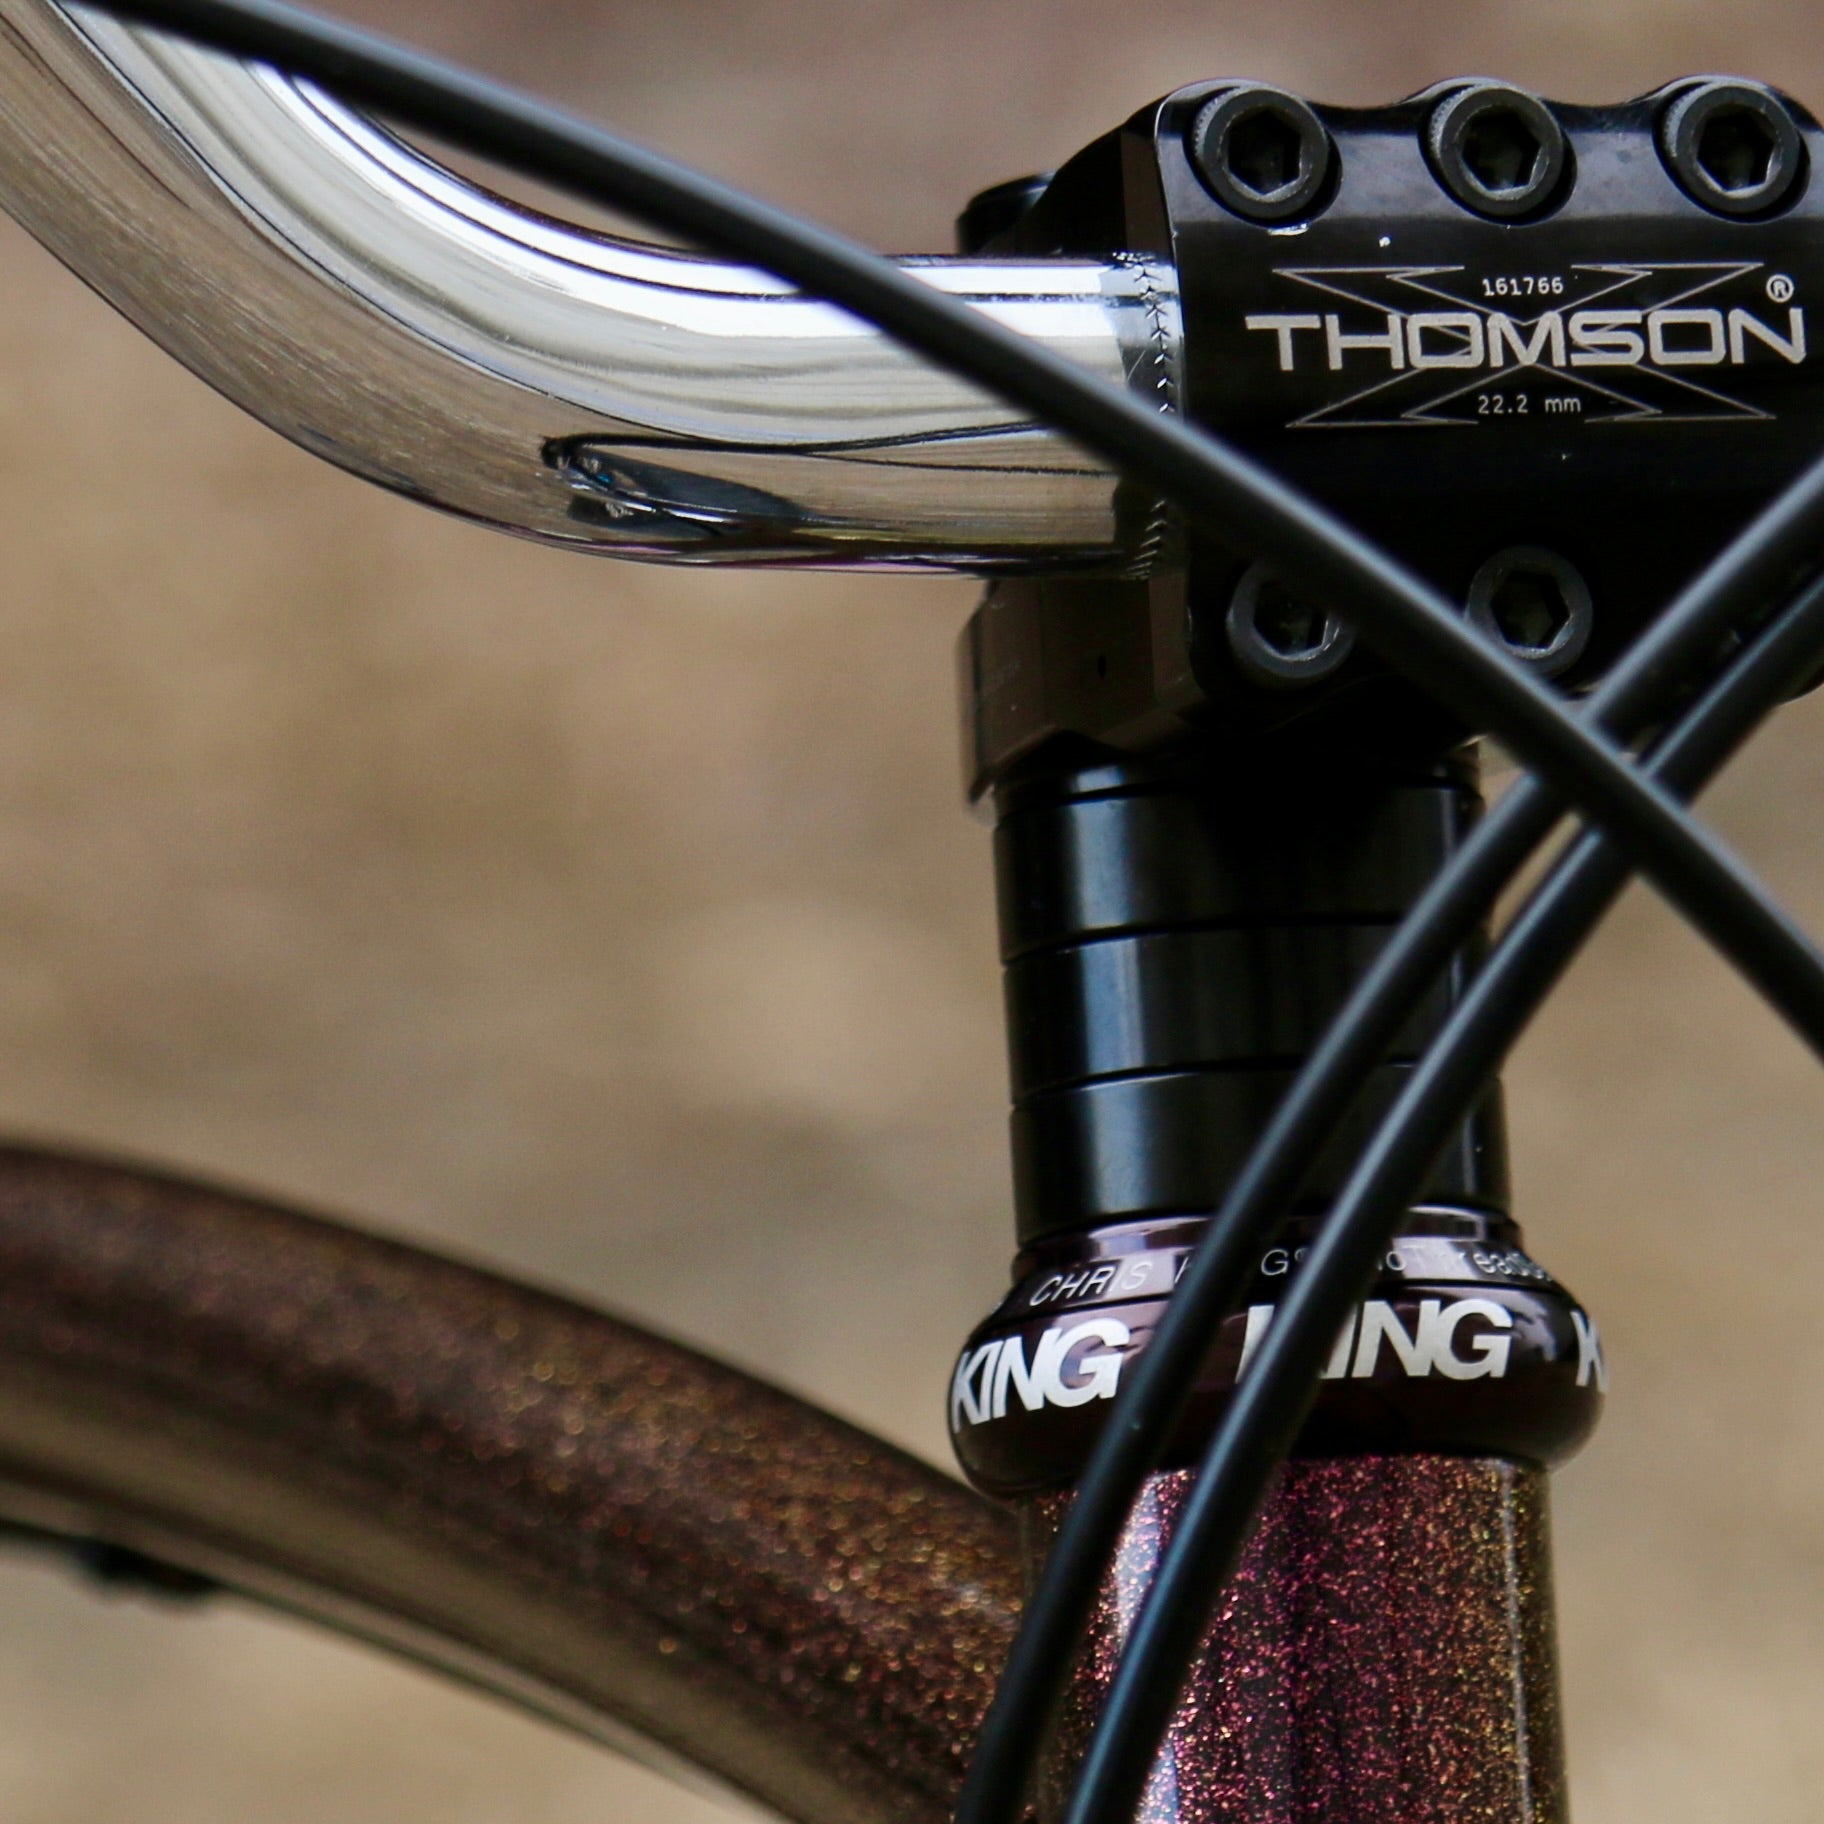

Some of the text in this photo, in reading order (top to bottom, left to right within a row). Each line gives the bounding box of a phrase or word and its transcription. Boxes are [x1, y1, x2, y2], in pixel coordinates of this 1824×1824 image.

[1481, 276, 1564, 297] 161766
[1245, 307, 1806, 371] THOMSON
[1478, 393, 1582, 415] 22.2 mm
[1029, 1258, 1153, 1307] CHRIS
[952, 1316, 1133, 1432] KING
